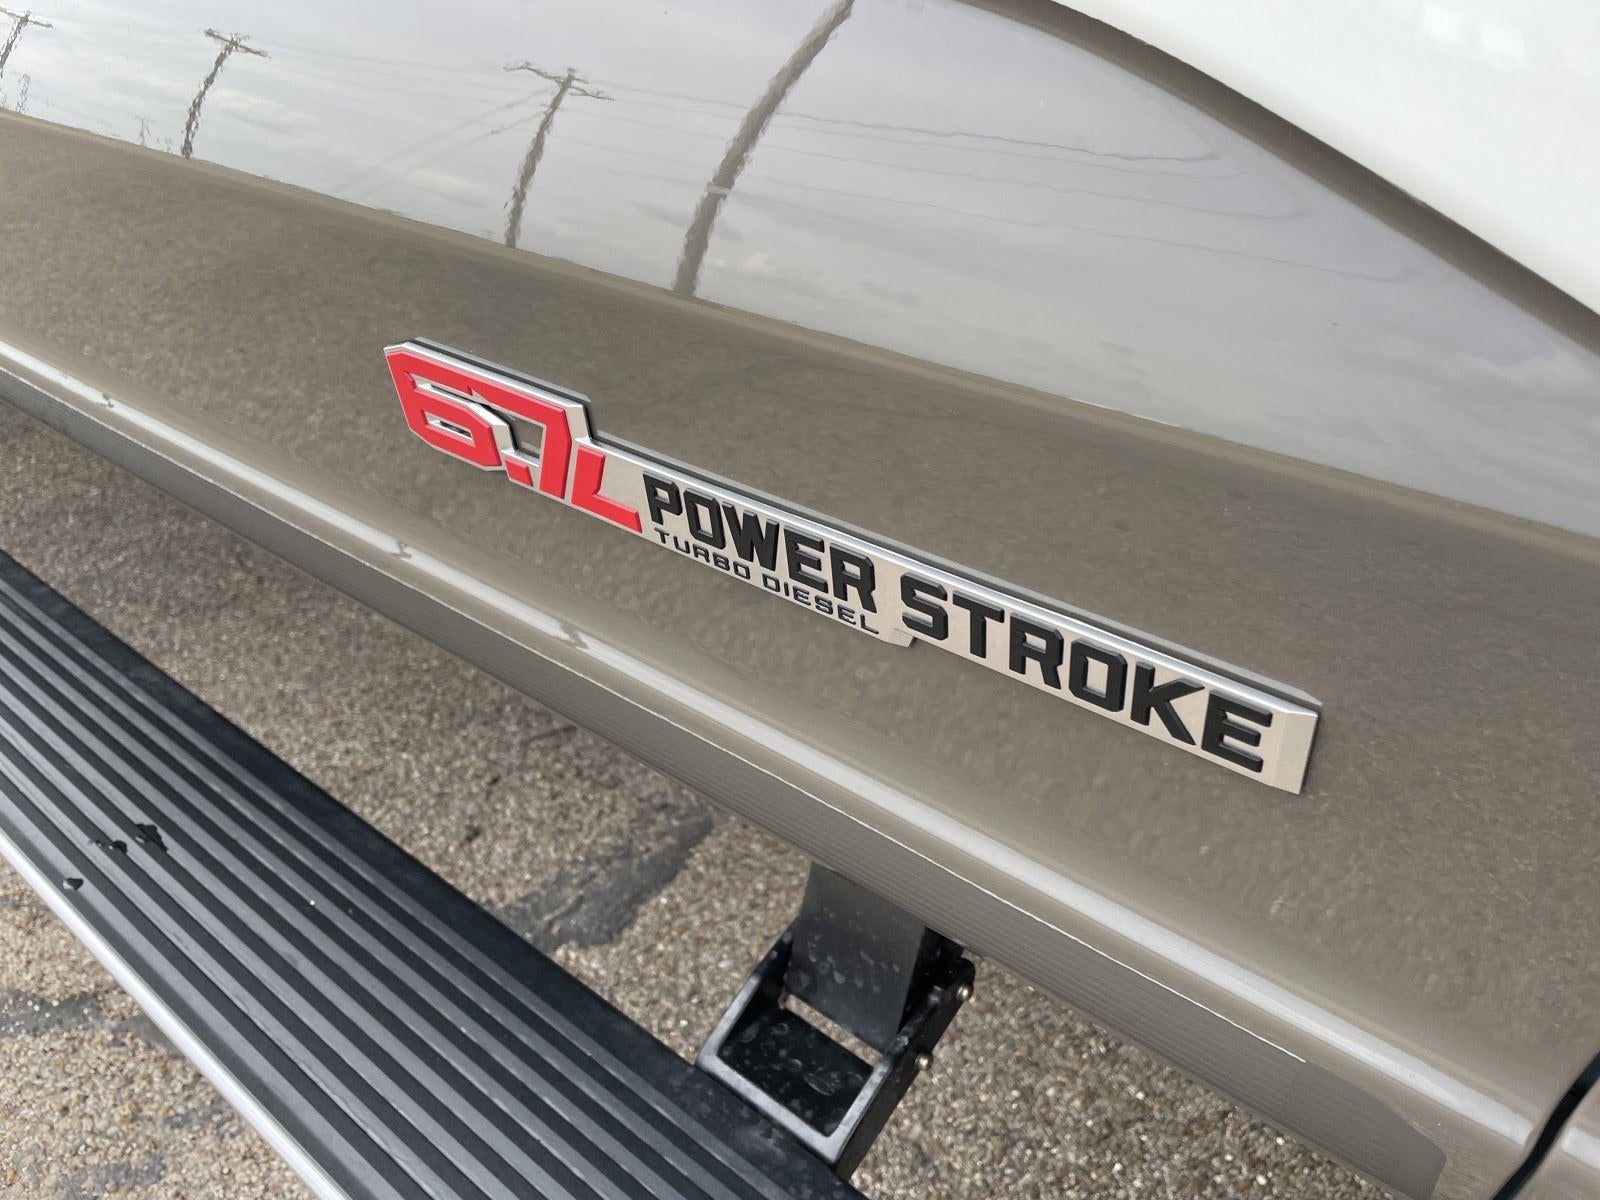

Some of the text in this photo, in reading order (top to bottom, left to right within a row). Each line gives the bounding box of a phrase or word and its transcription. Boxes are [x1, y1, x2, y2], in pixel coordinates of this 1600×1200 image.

[385, 350, 1274, 774] 6.7L POWER STROKE
[653, 526, 880, 636] TURBO DIESEL
